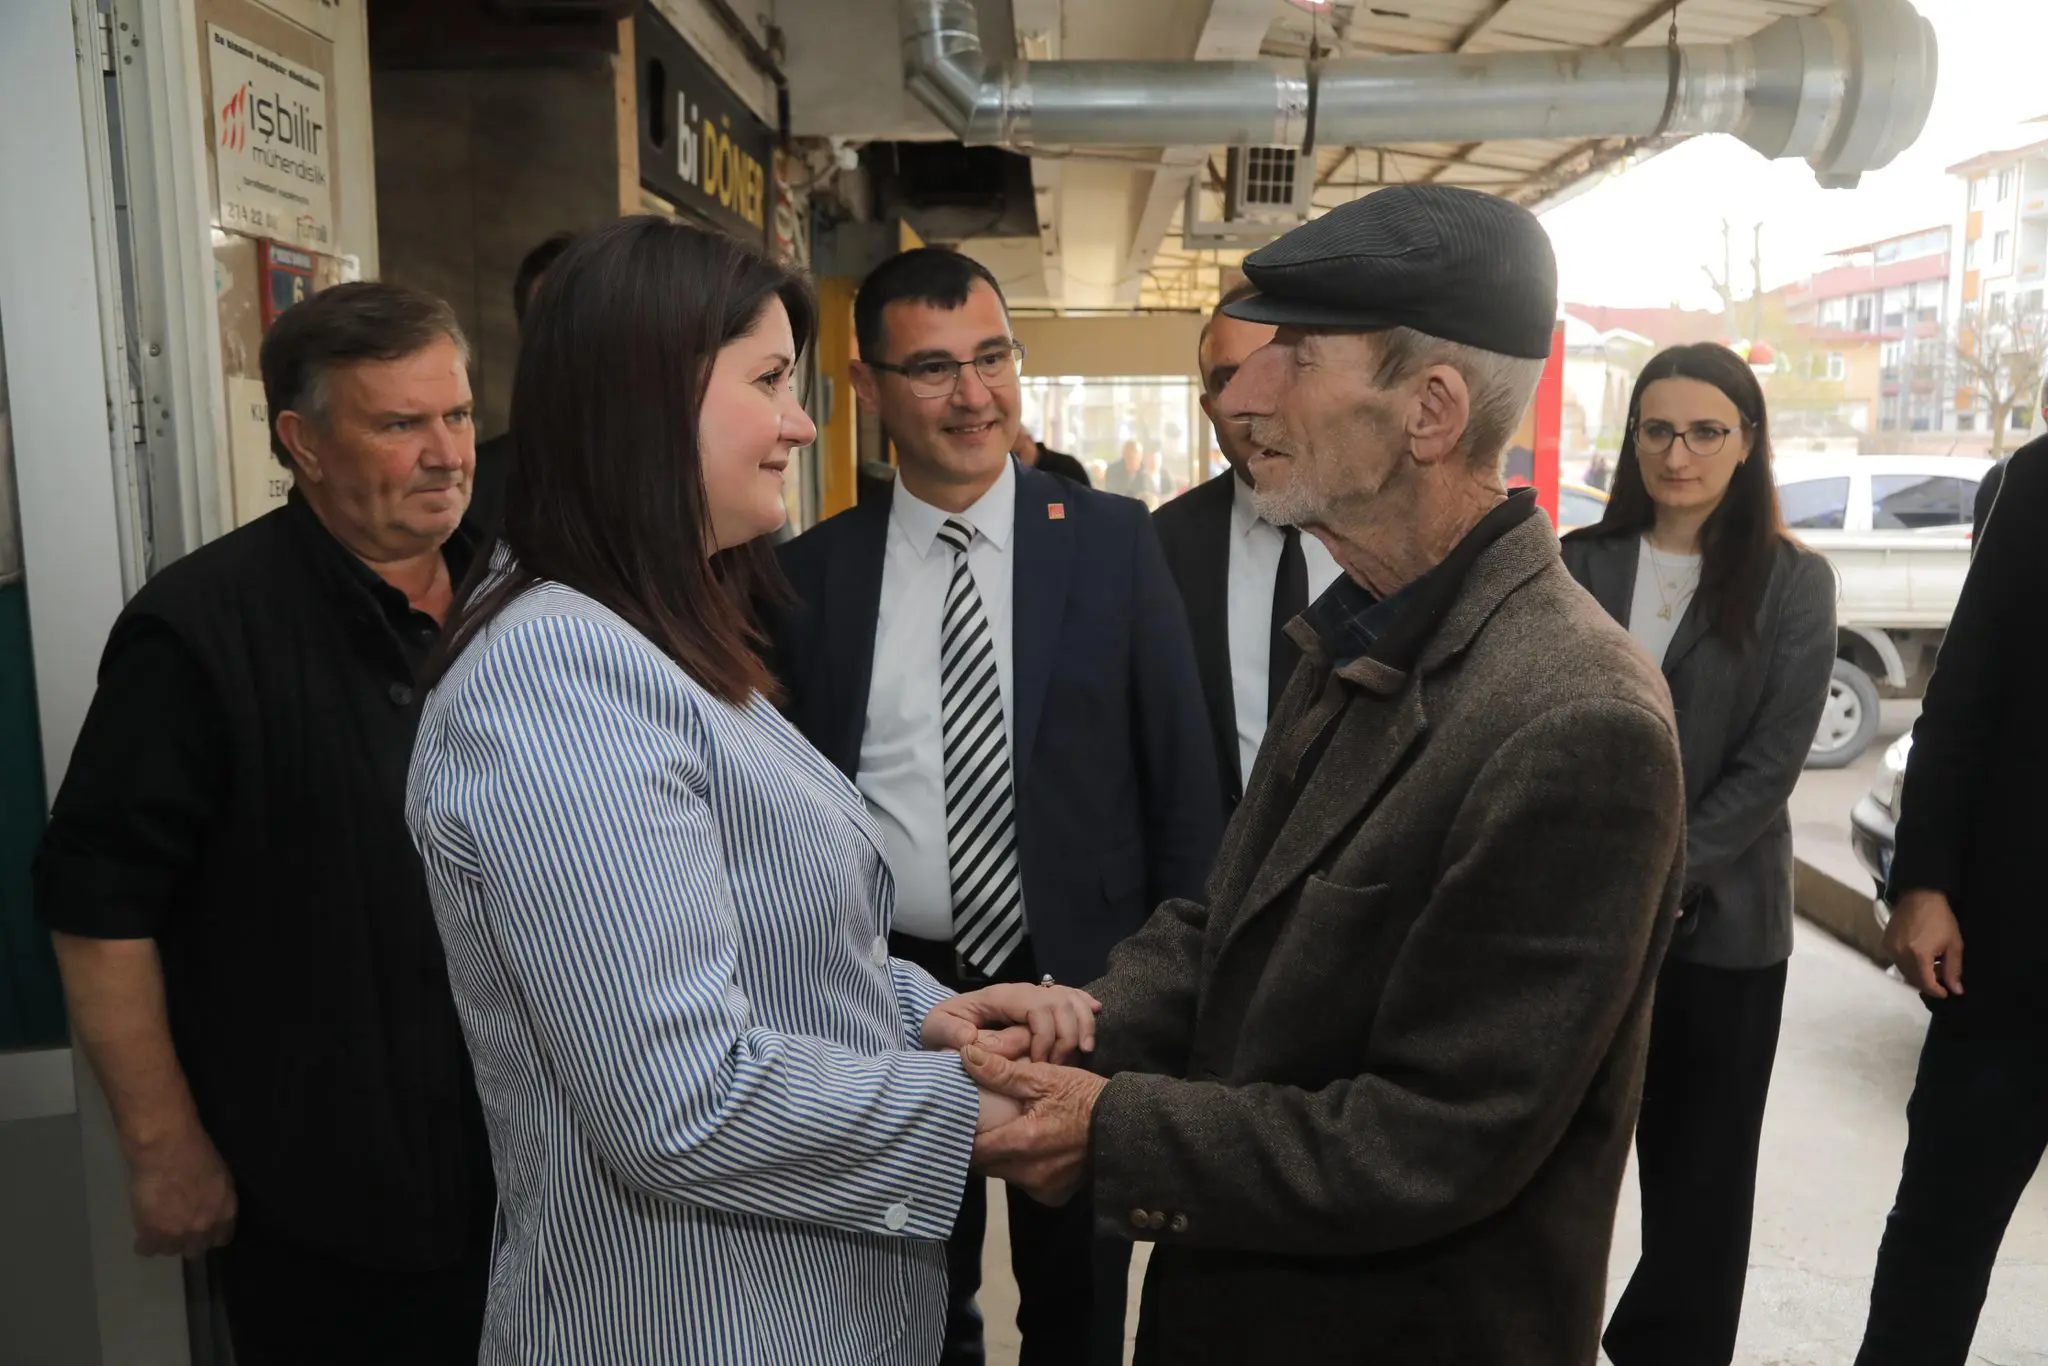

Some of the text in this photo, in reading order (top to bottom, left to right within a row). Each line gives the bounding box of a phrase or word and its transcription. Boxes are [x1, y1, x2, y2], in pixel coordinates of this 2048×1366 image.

[248, 81, 323, 156] işbilir
[678, 90, 763, 230] bi DÖNER
